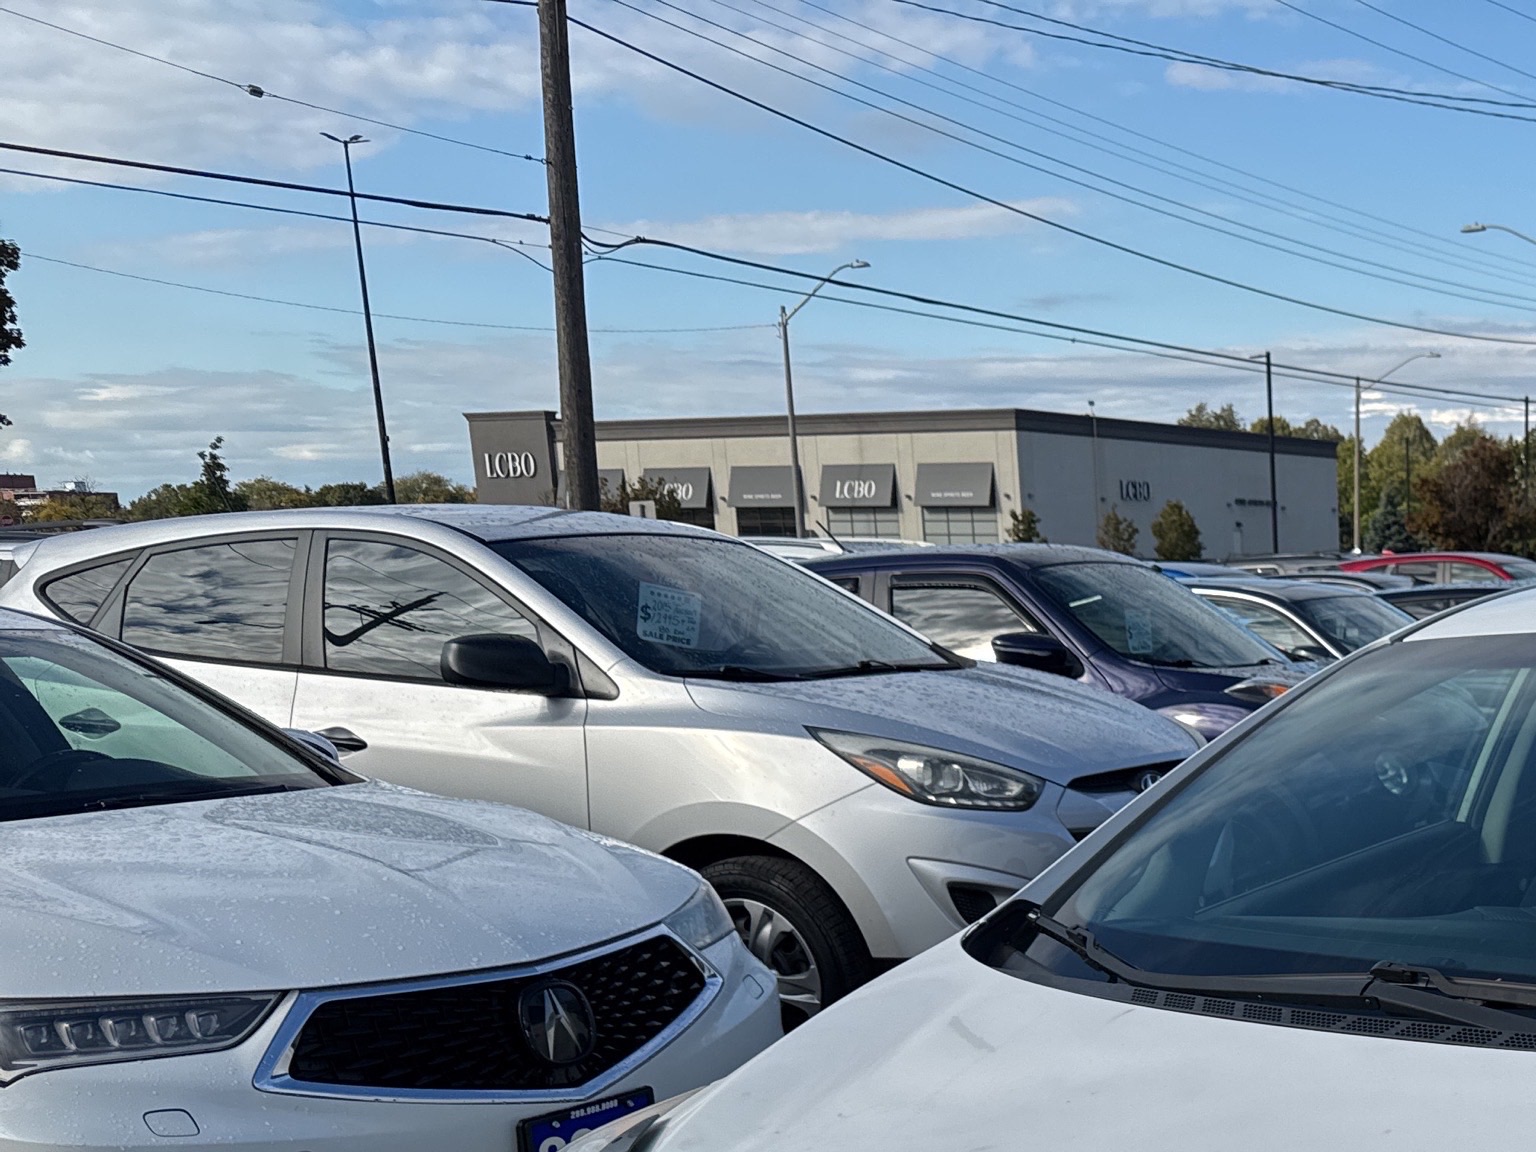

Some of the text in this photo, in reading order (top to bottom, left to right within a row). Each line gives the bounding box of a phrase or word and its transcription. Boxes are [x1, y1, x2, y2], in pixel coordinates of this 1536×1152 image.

[484, 451, 536, 479] LCBO
[835, 480, 877, 499] LCBO
[1119, 480, 1150, 501] LCBO
[642, 630, 664, 641] SALE
[666, 634, 692, 645] PRICE
